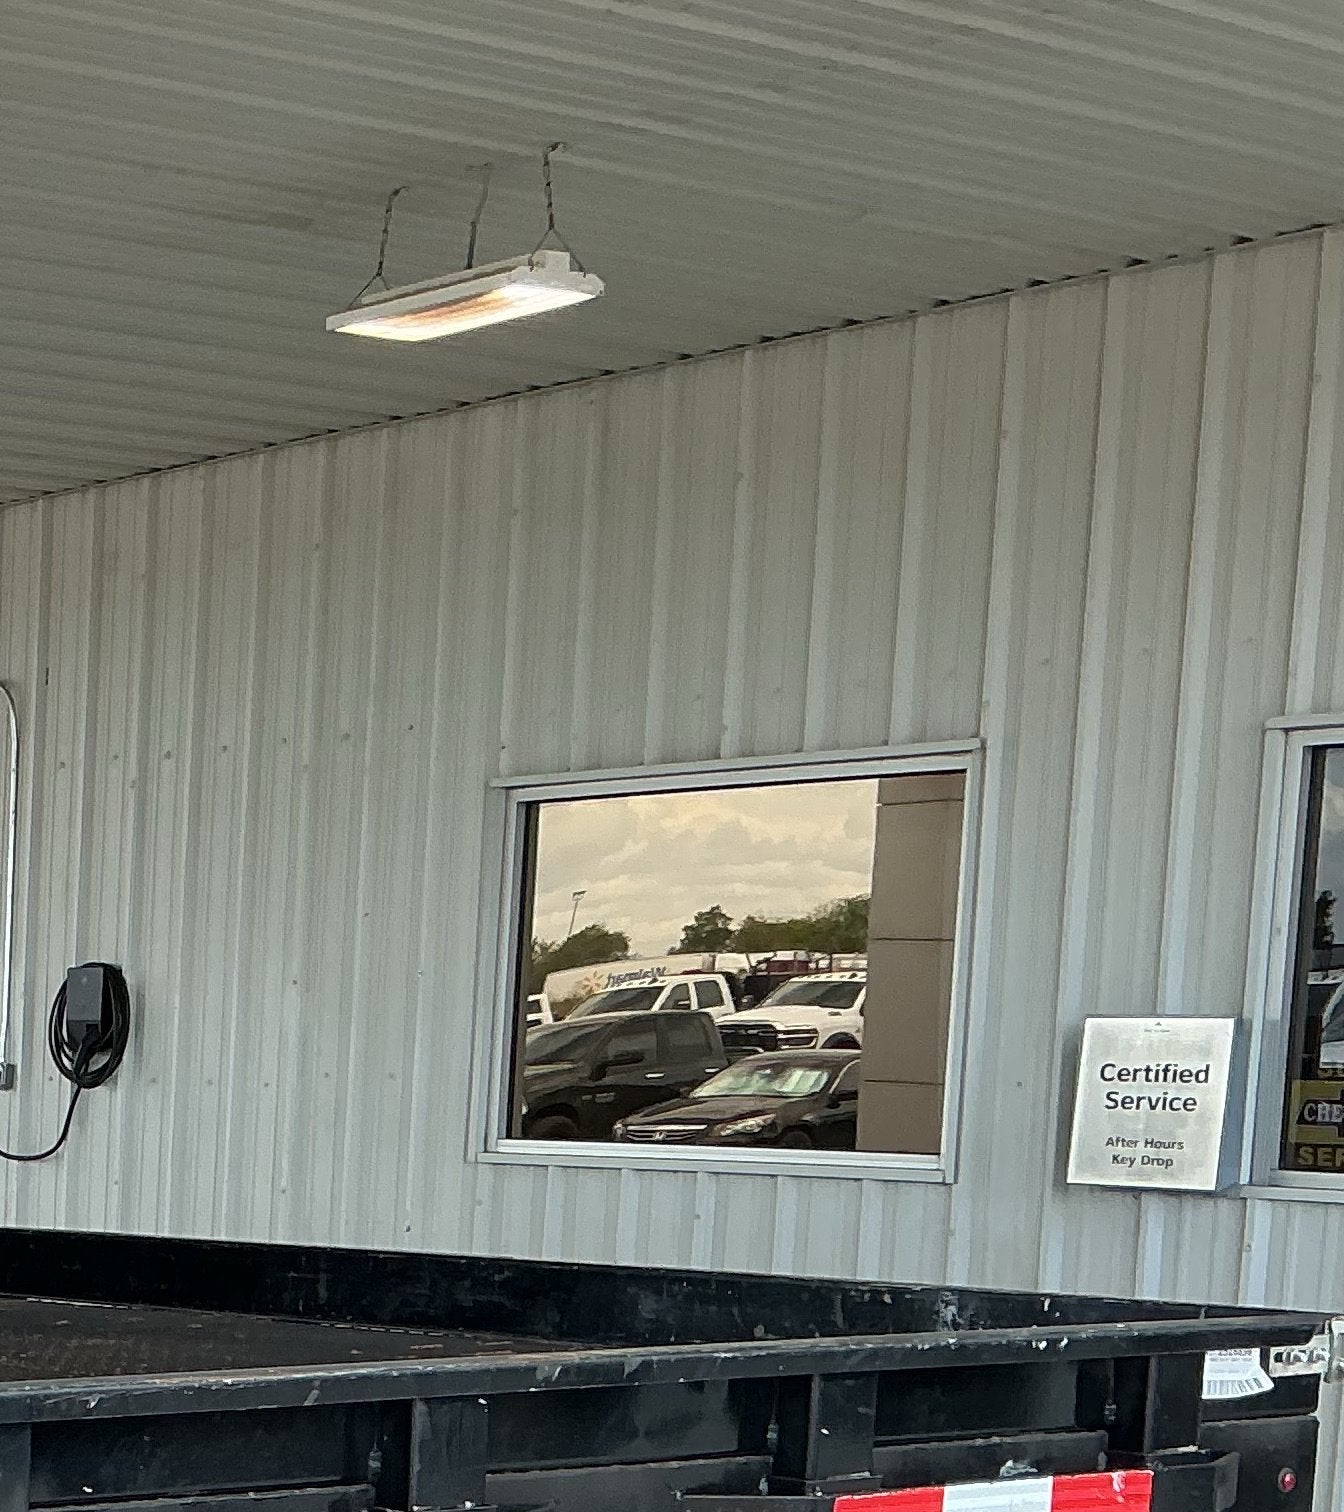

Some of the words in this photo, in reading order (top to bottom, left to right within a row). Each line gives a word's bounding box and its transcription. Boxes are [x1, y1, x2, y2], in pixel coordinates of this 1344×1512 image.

[1099, 1063, 1211, 1084] Certified
[1104, 1091, 1198, 1112] Service
[1303, 1103, 1344, 1122] CHE
[1105, 1136, 1140, 1149] After
[1143, 1138, 1185, 1150] Hours
[1111, 1154, 1137, 1168] Key
[1140, 1155, 1174, 1169] Drop
